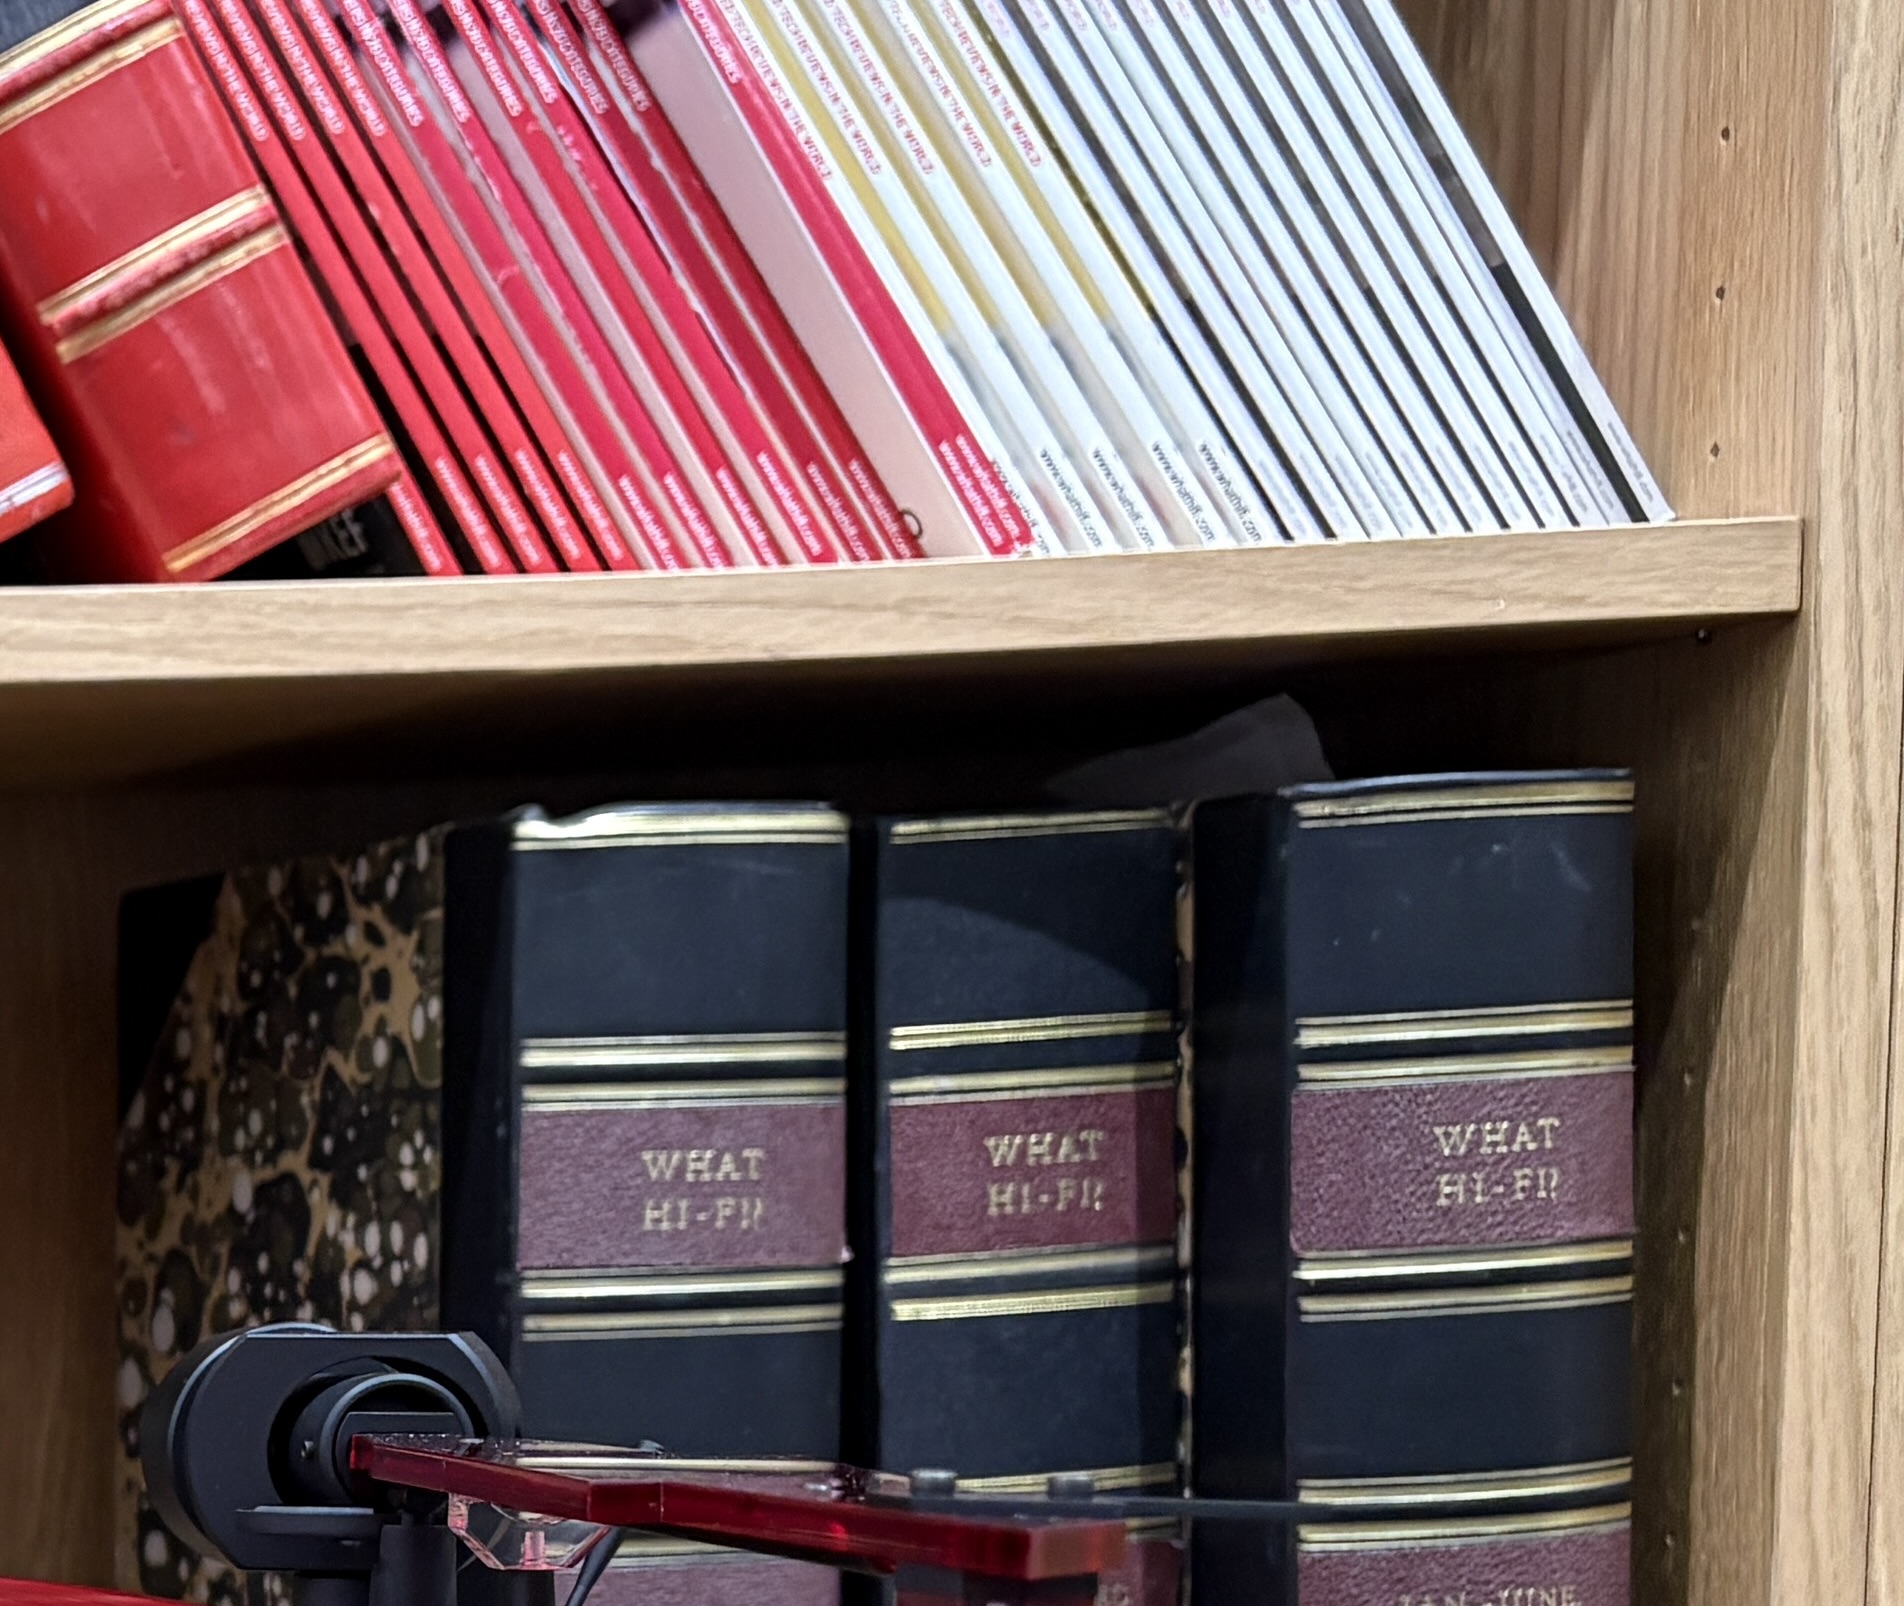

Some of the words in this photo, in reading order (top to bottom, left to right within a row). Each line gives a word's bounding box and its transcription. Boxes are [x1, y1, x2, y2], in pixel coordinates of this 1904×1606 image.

[983, 1129, 1105, 1167] WHAT
[1433, 1116, 1561, 1157] WHAT
[641, 1148, 766, 1182] WHAT
